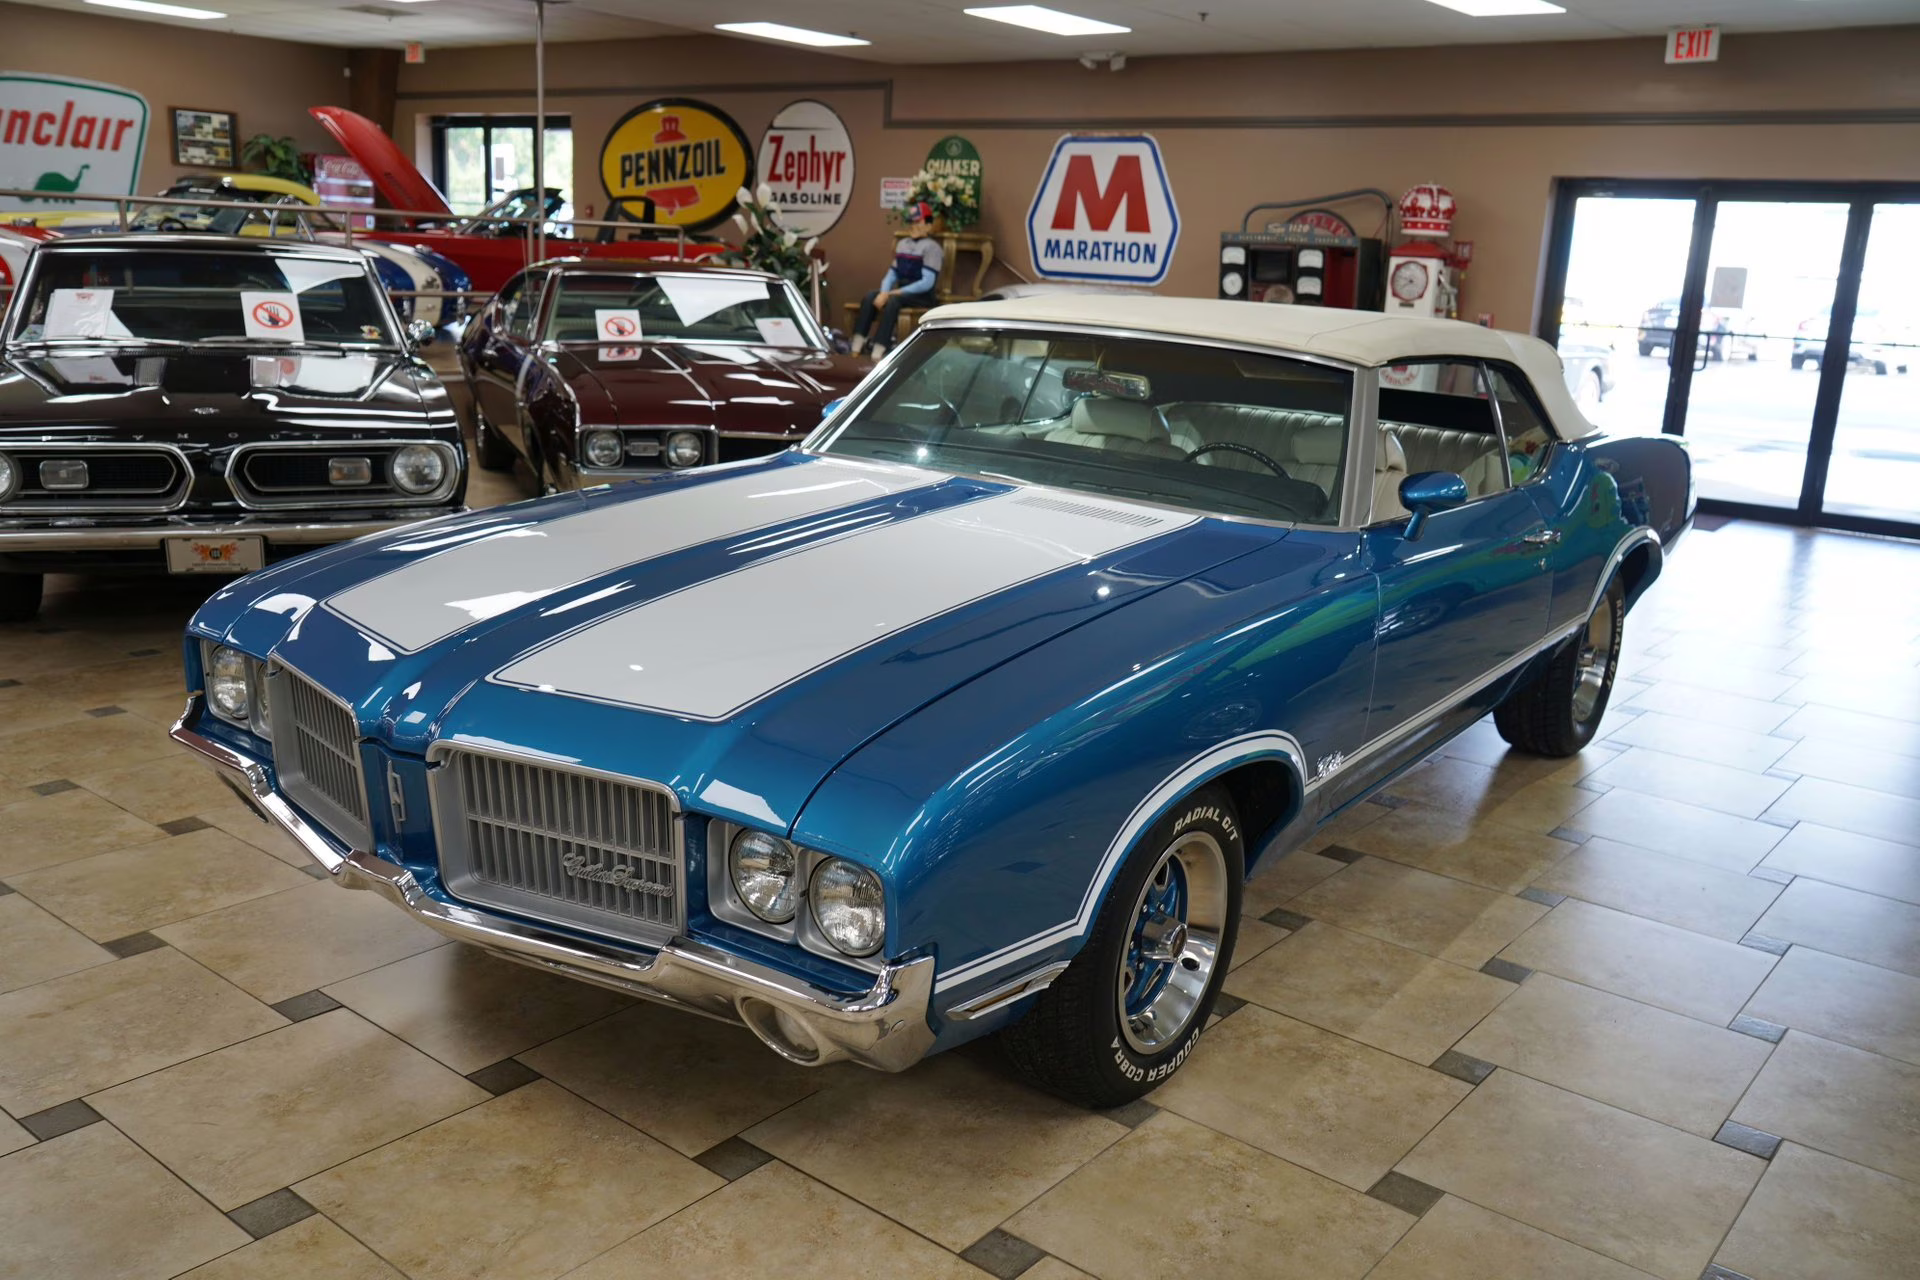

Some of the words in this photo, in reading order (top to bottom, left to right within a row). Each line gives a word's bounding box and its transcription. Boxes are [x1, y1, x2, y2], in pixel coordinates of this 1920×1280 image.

[1675, 30, 1712, 58] EXIT
[0, 99, 134, 152] nclair
[620, 138, 726, 189] PENNZOIL
[767, 134, 846, 191] Zephyr
[926, 158, 980, 177] QUAKER
[1050, 154, 1152, 234] M
[1043, 238, 1157, 265] MARATHON
[1173, 806, 1221, 836] RADIAL
[1221, 816, 1239, 841] G/T
[1110, 1036, 1145, 1082] COBRA
[1145, 1027, 1200, 1083] COOPER
